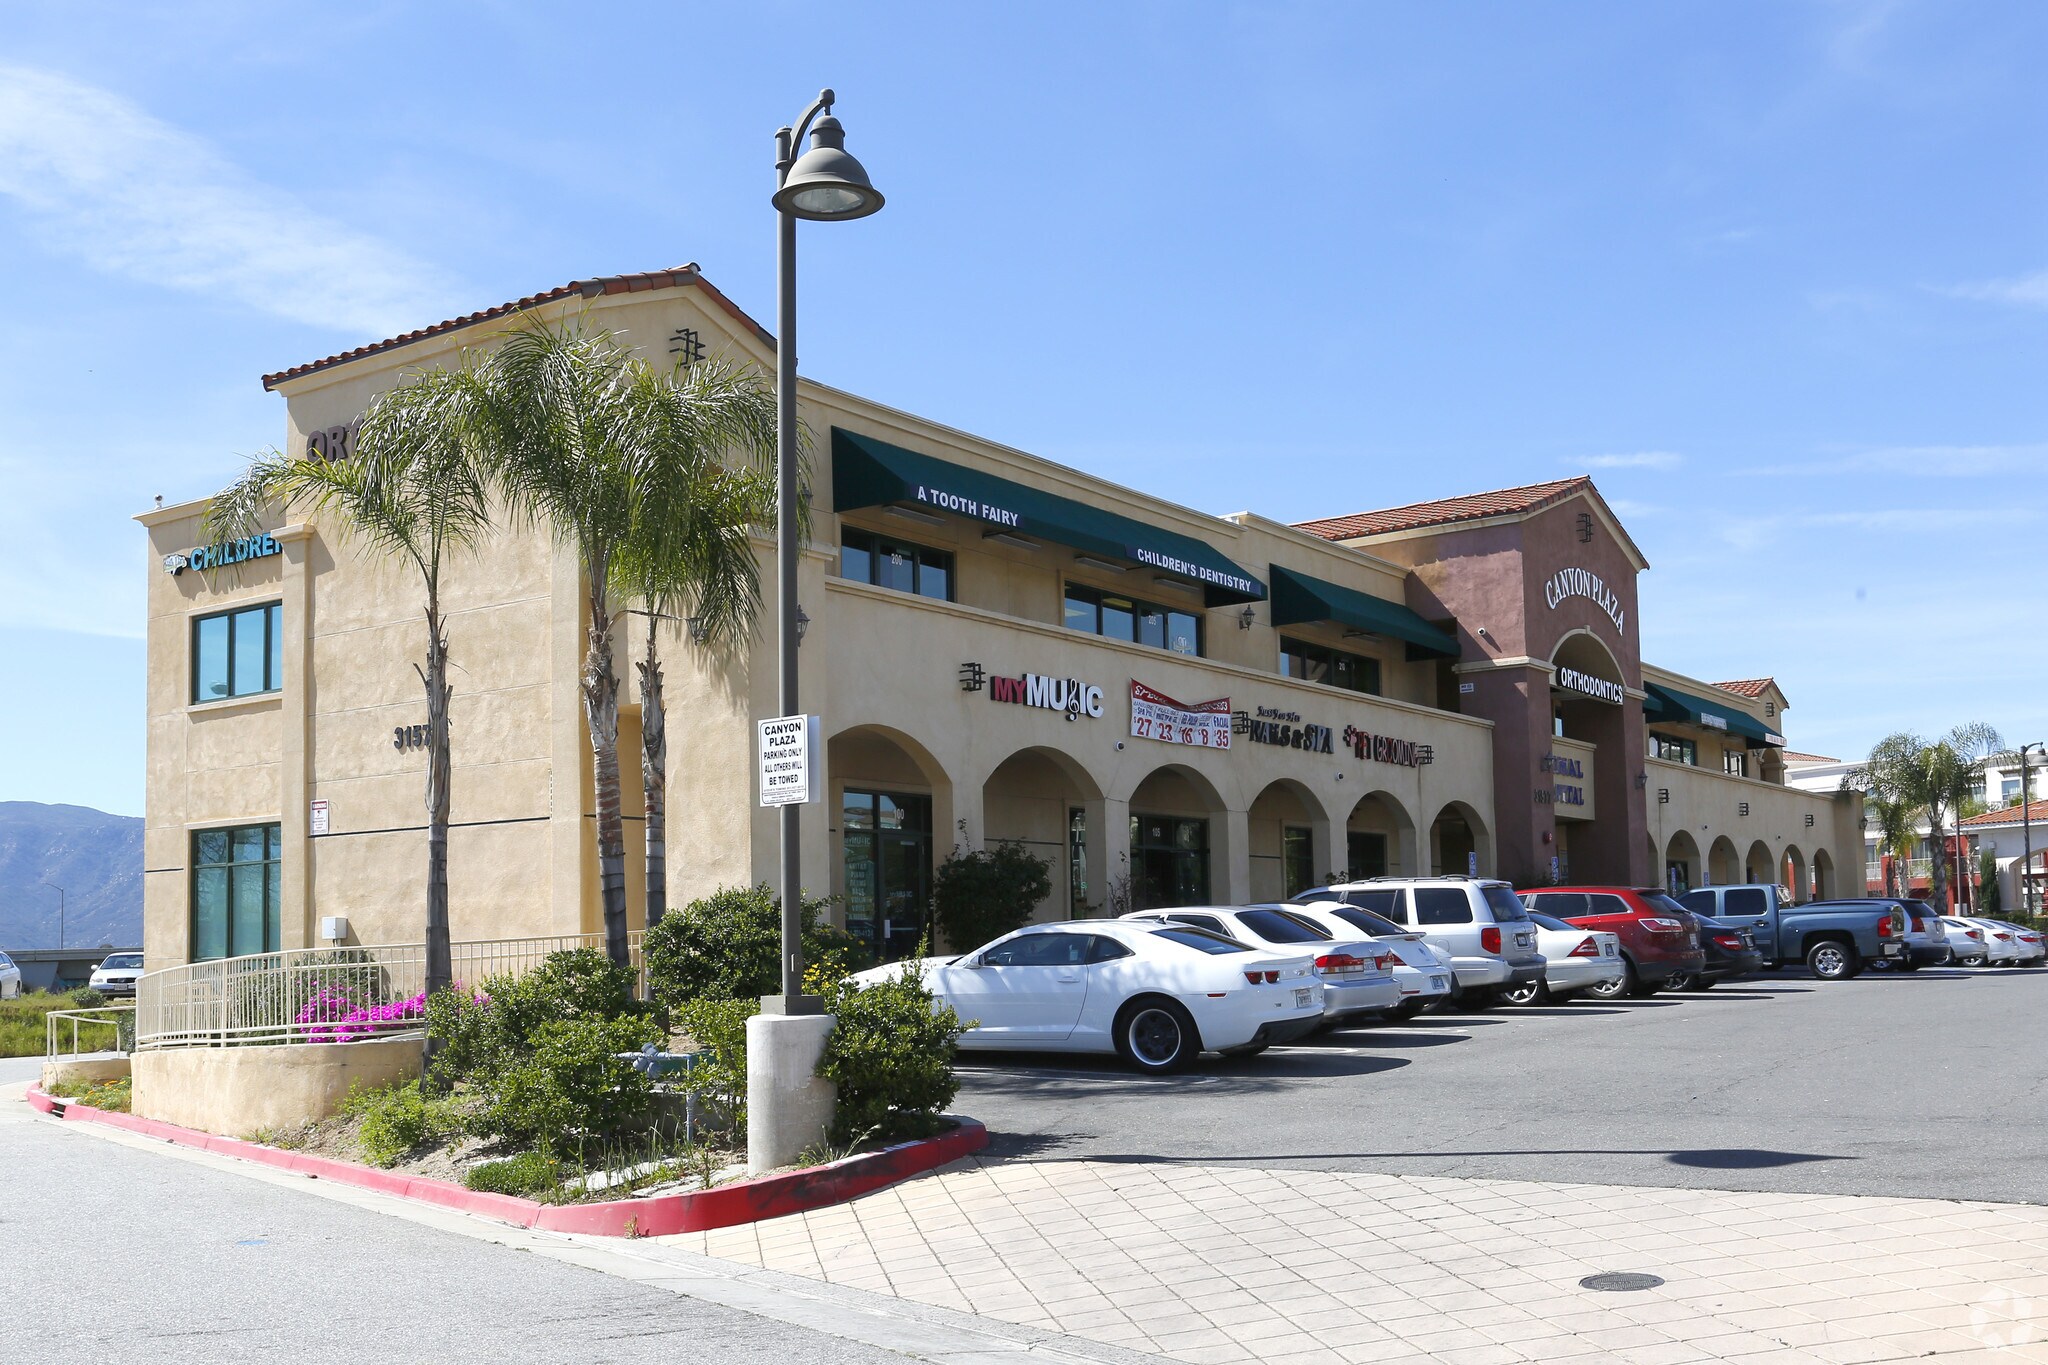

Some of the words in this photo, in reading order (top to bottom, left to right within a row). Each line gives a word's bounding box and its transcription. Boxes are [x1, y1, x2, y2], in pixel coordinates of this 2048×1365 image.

[917, 485, 927, 501] A
[930, 489, 976, 515] TOOTH
[982, 504, 1018, 526] FAIRY
[1137, 548, 1197, 577] CHILDREN'S
[1200, 566, 1251, 592] DENTISTRY
[1546, 567, 1590, 609] CANYON
[1592, 574, 1624, 636] PLAZA
[1561, 667, 1623, 703] ORTHODONTICS
[765, 722, 801, 735] CANYON
[769, 735, 796, 746] PLAZA
[1249, 719, 1290, 746] NAILS
[1291, 729, 1304, 749] &
[1304, 724, 1335, 755] SPA
[764, 749, 787, 760] PARKING
[788, 748, 802, 757] ONLY
[764, 764, 773, 773] ALL
[773, 762, 791, 772] OTHERS
[792, 761, 802, 769] WILL
[769, 777, 777, 785] BE
[778, 774, 799, 785] TOWED
